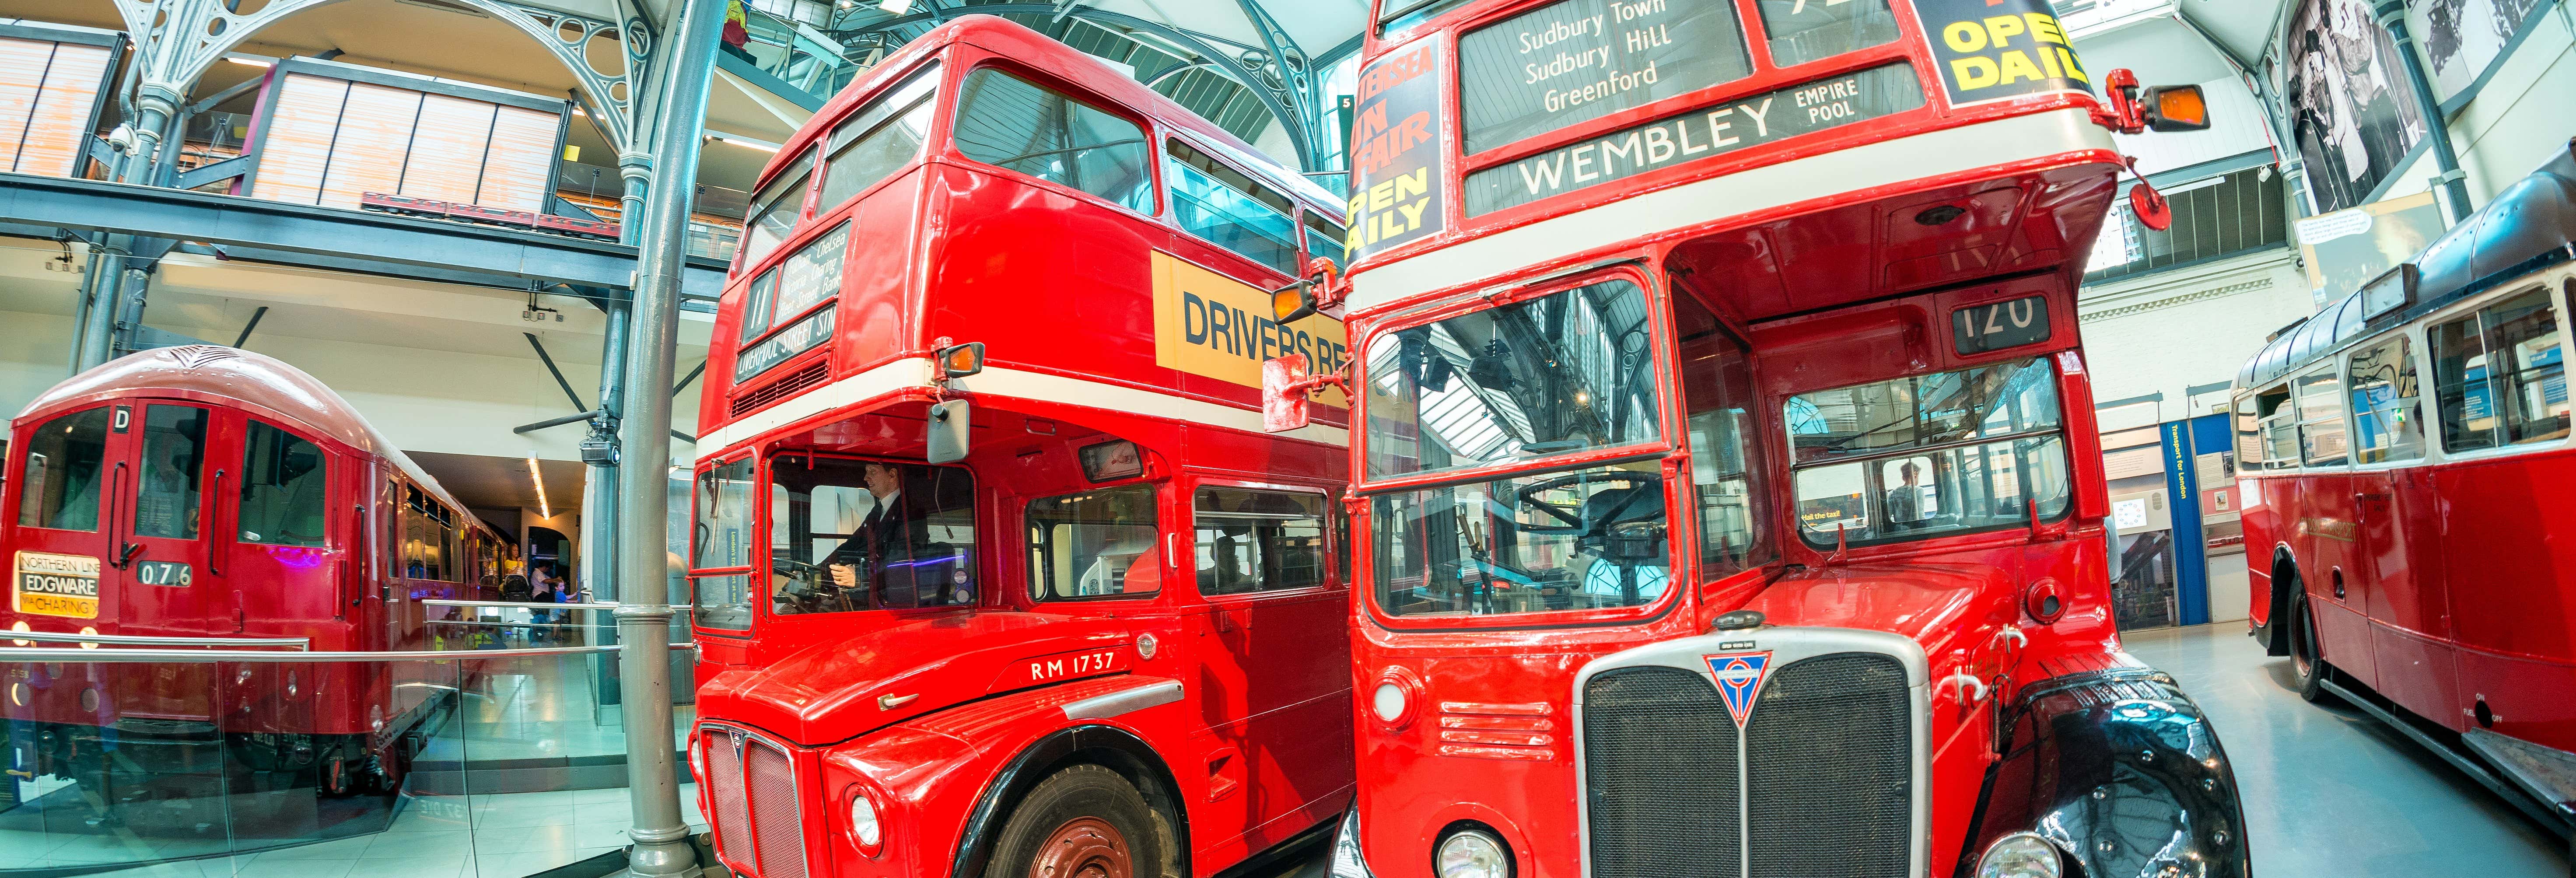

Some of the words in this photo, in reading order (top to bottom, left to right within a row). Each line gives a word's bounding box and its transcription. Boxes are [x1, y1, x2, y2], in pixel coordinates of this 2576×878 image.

[1519, 14, 1603, 54] Sudbury
[1610, 0, 1666, 24] Town
[1526, 45, 1610, 84] Sudbury
[1626, 24, 1672, 54] Hill
[1357, 45, 1435, 106] TERSEA
[1544, 60, 1658, 113] Greenford
[1794, 79, 1858, 108] EMPIRE
[1343, 98, 1351, 108] 5
[1808, 100, 1855, 124] POOL
[1352, 111, 1434, 188] FAIR
[1519, 98, 1773, 195] WEMBLEY
[1346, 166, 1428, 228] PEN
[817, 233, 846, 259] Chelsea
[1344, 196, 1431, 262] AILY
[812, 258, 837, 281] Charing
[751, 282, 769, 329] 11
[797, 286, 819, 308] Street
[822, 271, 841, 295] Bank
[1183, 290, 1314, 376] DRIVERS
[1964, 298, 2033, 338] 120
[738, 337, 778, 374] LIVERPOOL
[781, 316, 815, 353] STREET
[816, 305, 836, 336] STN
[115, 410, 130, 428] D
[2171, 424, 2182, 459] Transport
[2178, 472, 2187, 499] London
[21, 556, 77, 572] NORTHERN
[81, 561, 100, 573] LINE
[26, 574, 96, 595] EDGWARE
[35, 598, 89, 614] CHARING
[1031, 659, 1064, 680] RM
[1074, 652, 1114, 673] 1737
[2463, 708, 2475, 717] FUEL
[2476, 693, 2485, 701] ON
[2491, 714, 2502, 724] OFF
